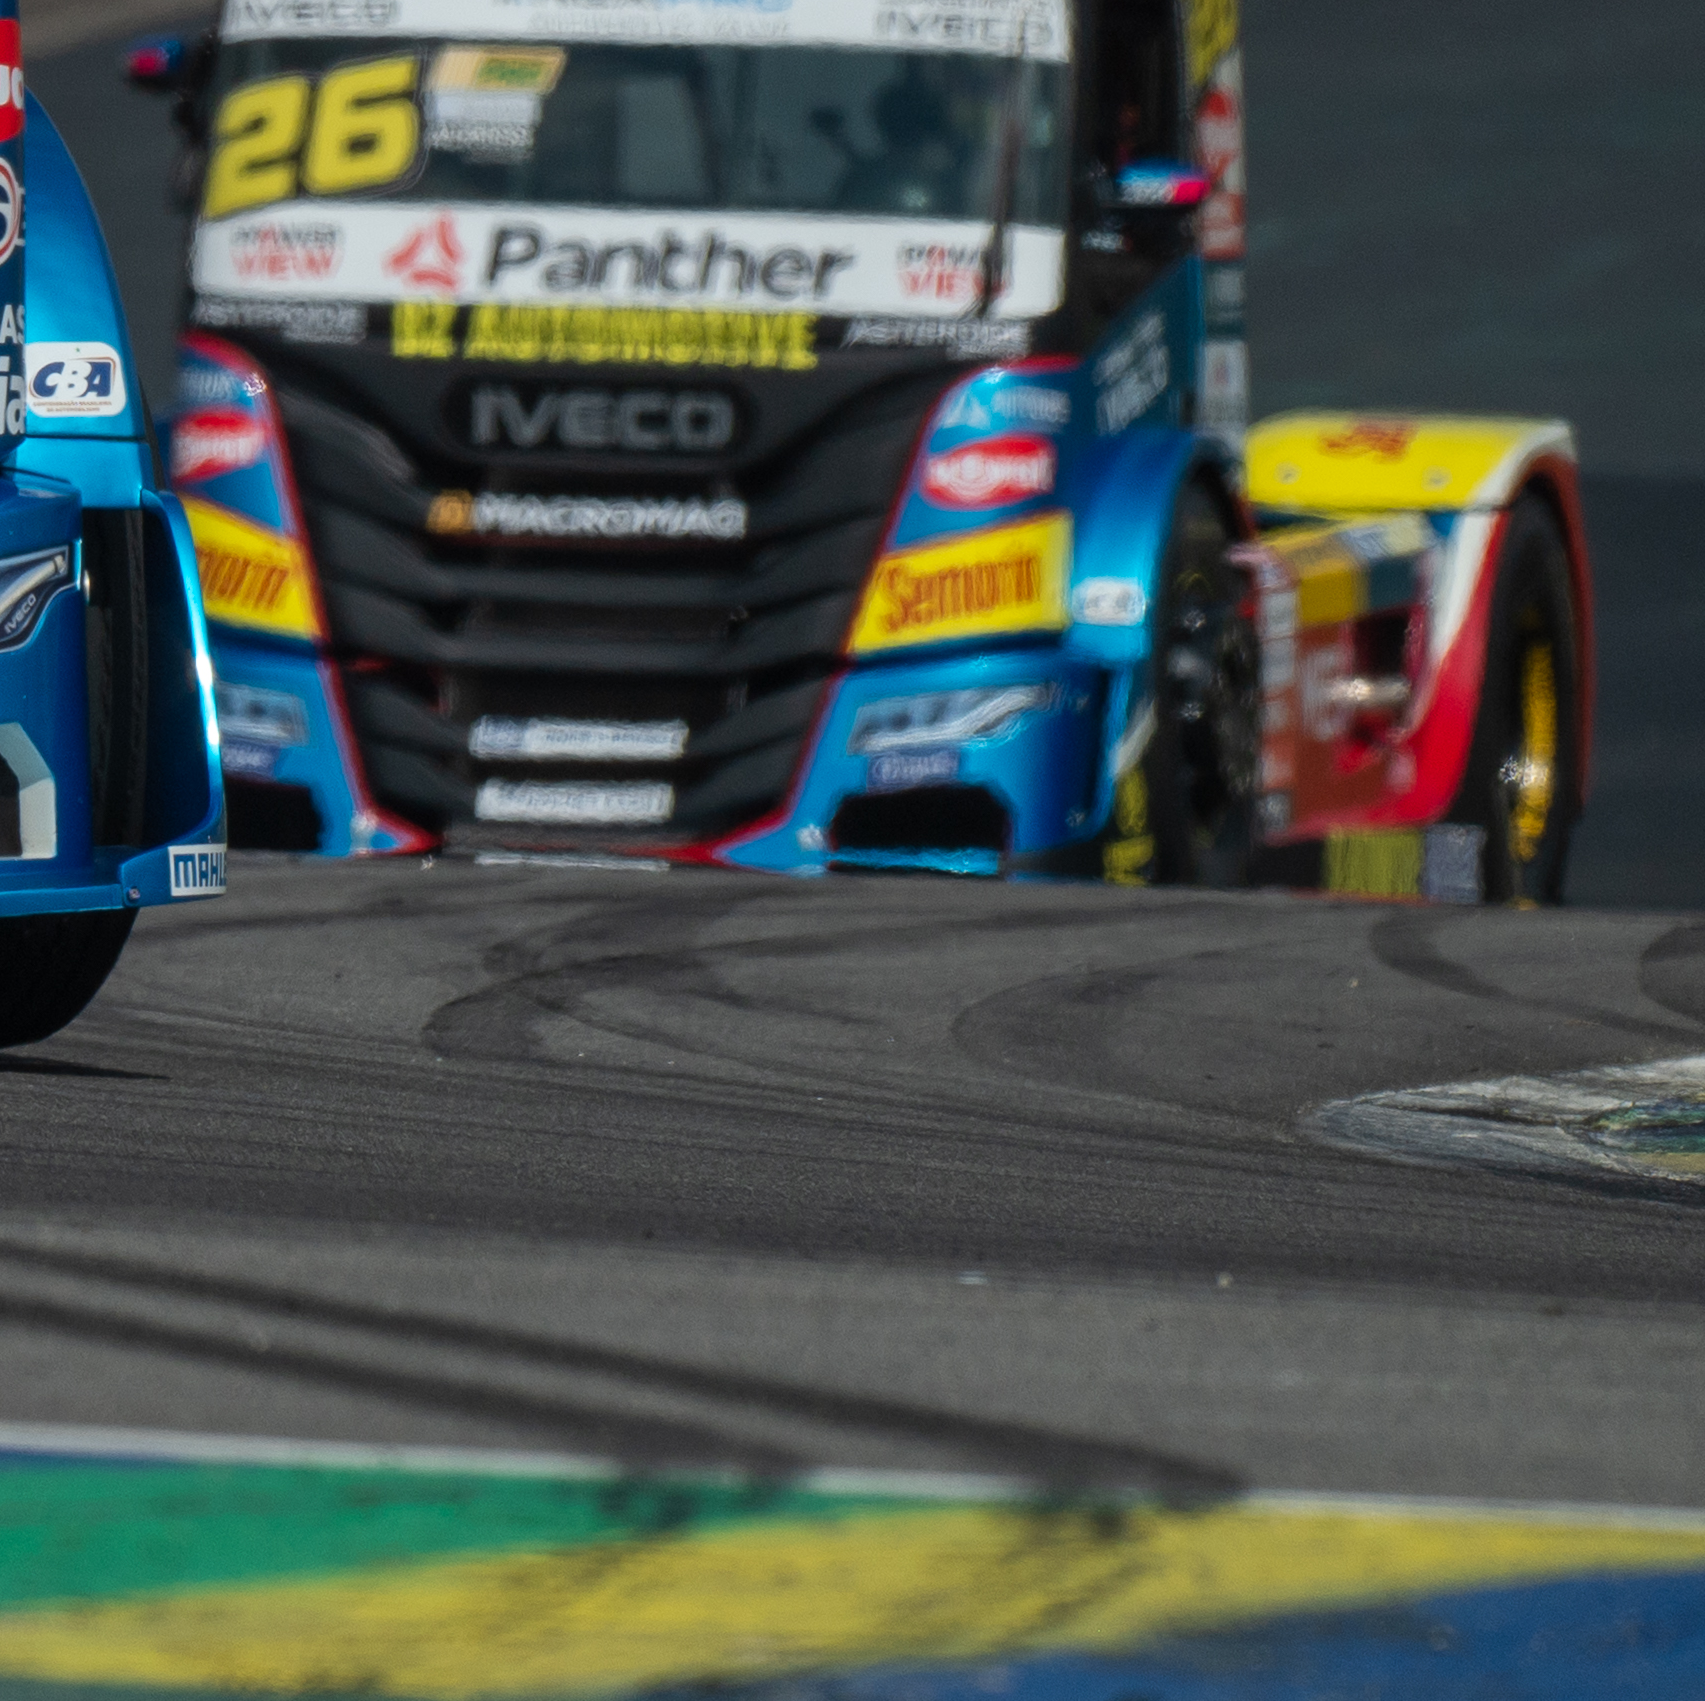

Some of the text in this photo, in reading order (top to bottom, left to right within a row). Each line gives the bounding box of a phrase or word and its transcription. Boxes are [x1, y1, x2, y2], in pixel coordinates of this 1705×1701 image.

[203, 53, 422, 219] 26
[488, 224, 857, 300] Panther
[32, 361, 112, 398] CBA
[470, 390, 738, 449] IVECO
[3, 594, 37, 636] IVECO
[173, 851, 228, 888] MAHL
